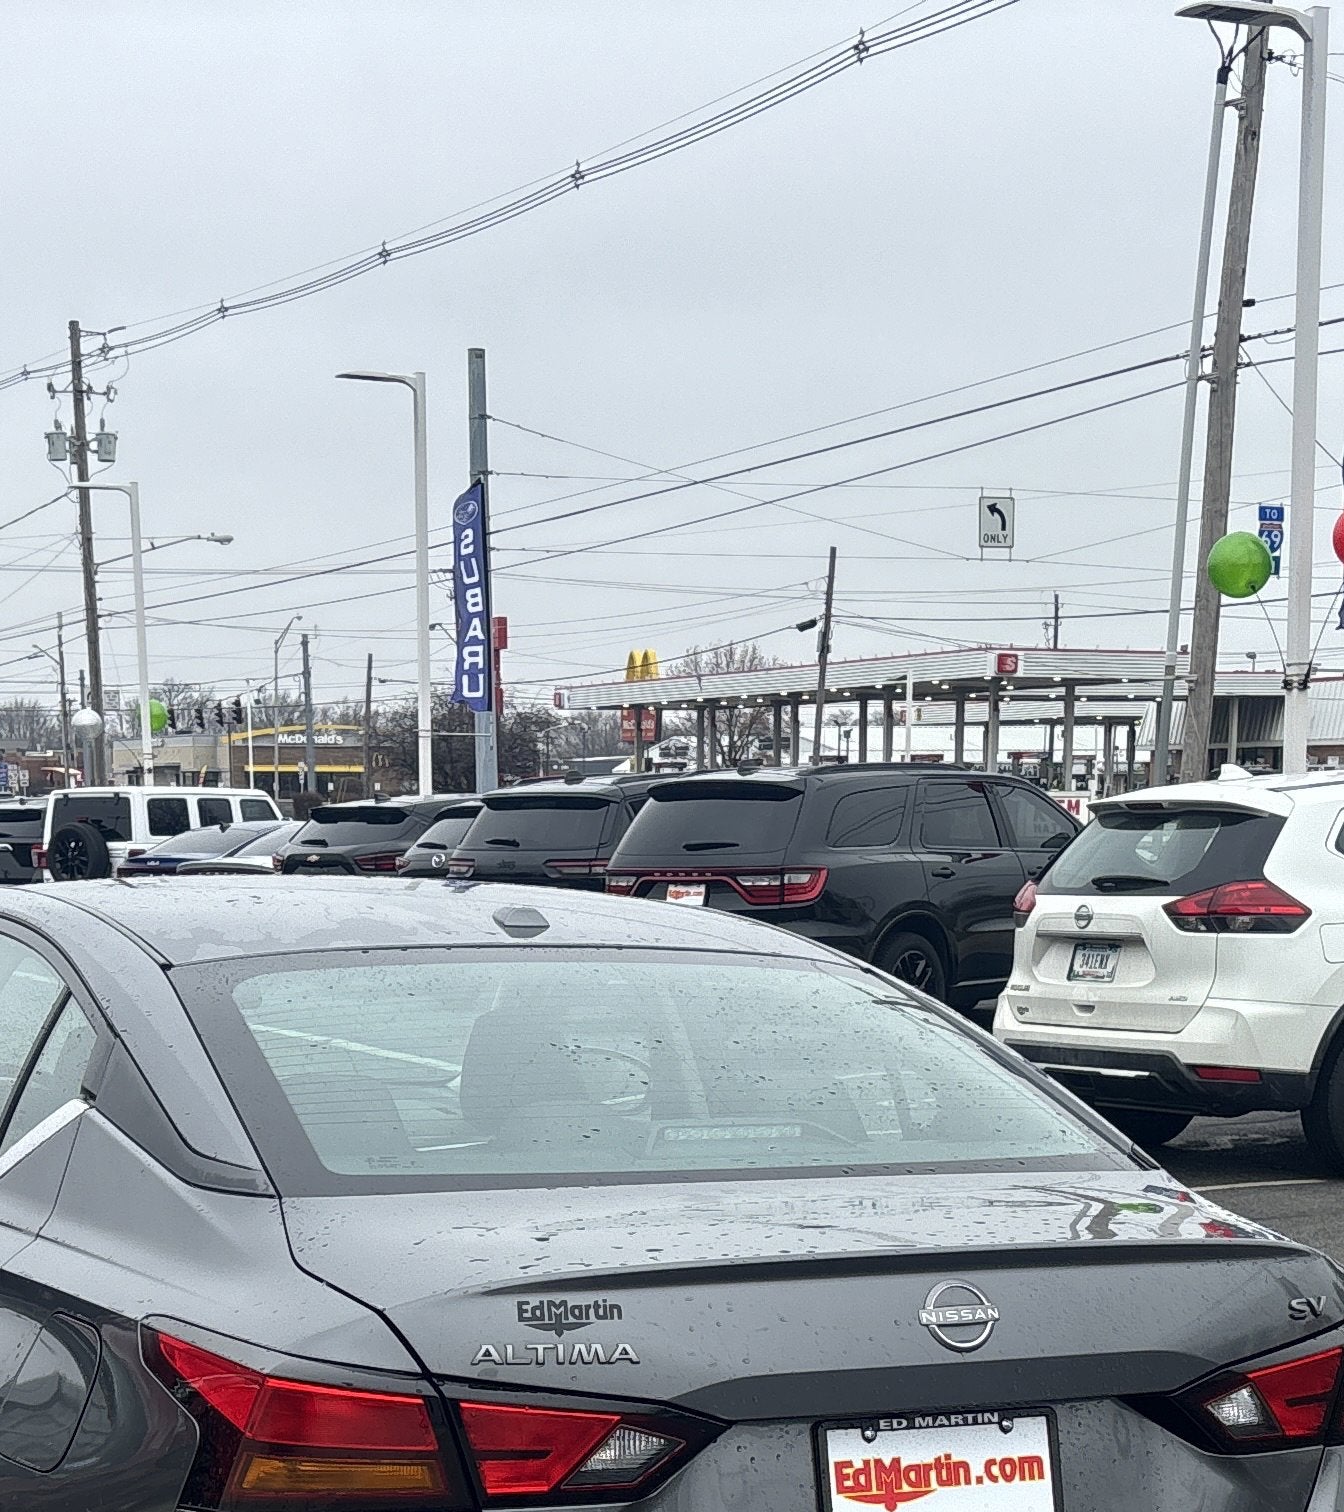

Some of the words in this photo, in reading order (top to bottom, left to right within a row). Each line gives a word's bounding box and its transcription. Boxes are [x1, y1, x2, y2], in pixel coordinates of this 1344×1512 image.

[1265, 509, 1278, 519] TO
[983, 533, 1008, 543] ONLY
[1261, 531, 1281, 548] 69
[277, 733, 343, 744] McDnald's
[921, 1308, 1000, 1323] NISSAN
[1288, 1295, 1327, 1320] SV
[471, 1343, 641, 1366] ALTIMA
[878, 1417, 908, 1430] ED
[914, 1412, 1000, 1428] MARTIN
[834, 1454, 1045, 1497] EdMartin.com
